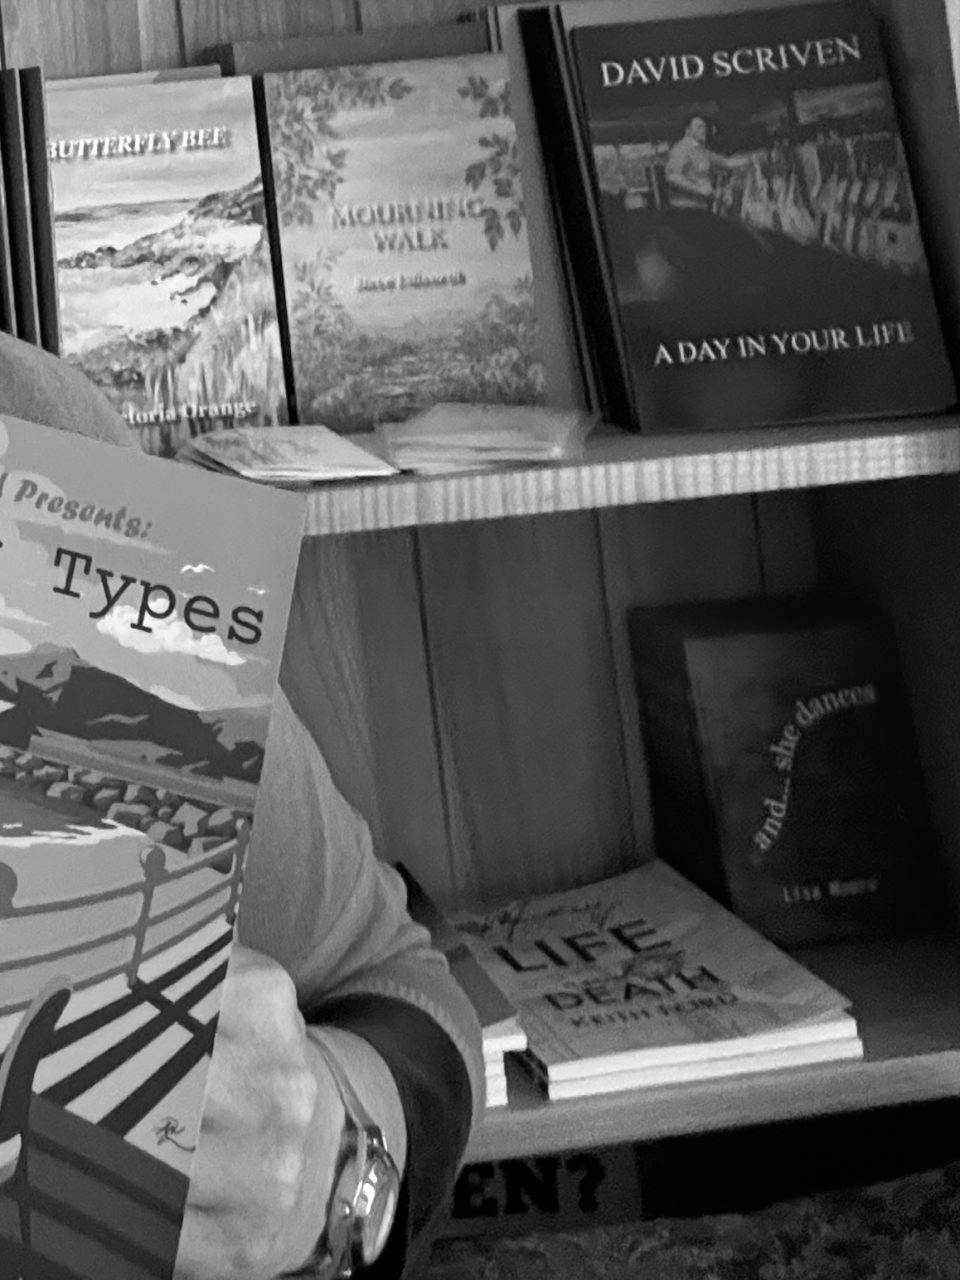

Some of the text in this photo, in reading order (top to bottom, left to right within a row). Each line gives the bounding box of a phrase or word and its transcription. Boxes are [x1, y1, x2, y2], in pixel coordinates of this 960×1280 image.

[600, 35, 862, 87] DAVID SCRIVEN
[48, 125, 232, 159] BUTTERFLY BEE
[654, 320, 915, 365] A DAY IN YOUR LIFE
[14, 479, 153, 538] Presents:
[52, 547, 265, 646] Types
[492, 918, 673, 973] LIFE
[543, 965, 721, 1011] DEATH
